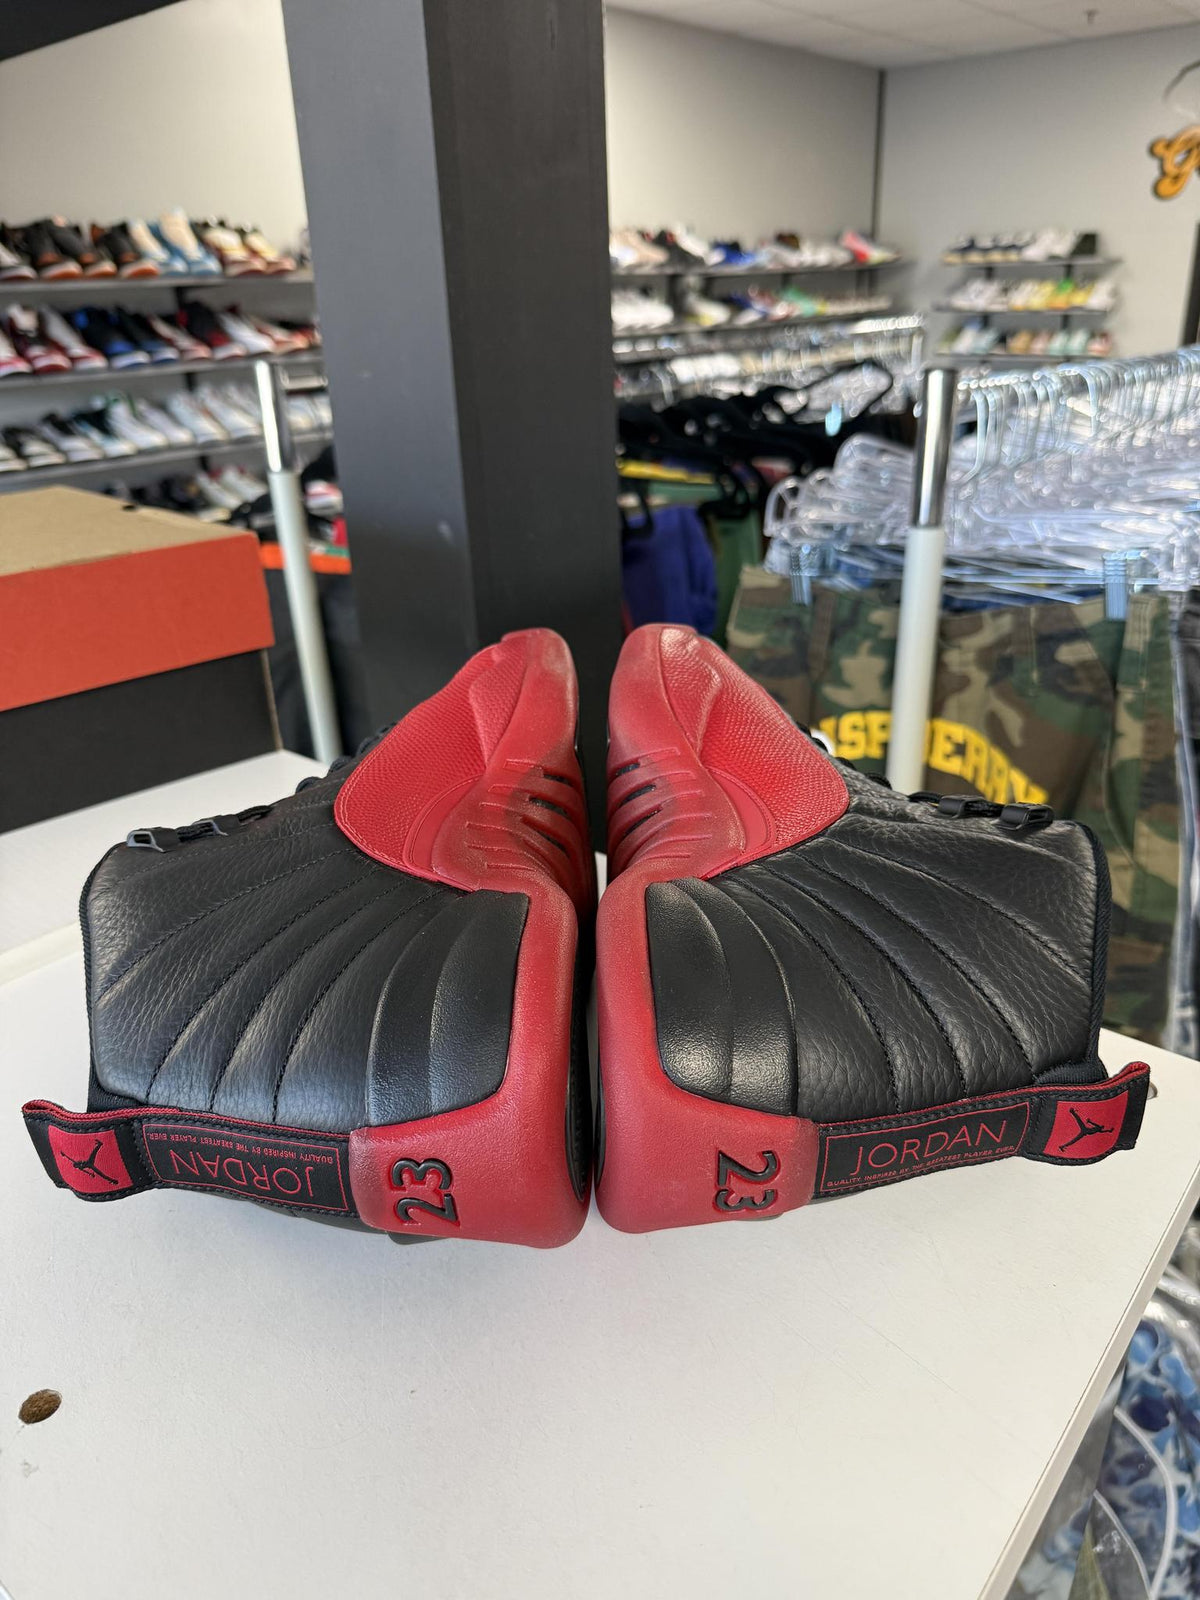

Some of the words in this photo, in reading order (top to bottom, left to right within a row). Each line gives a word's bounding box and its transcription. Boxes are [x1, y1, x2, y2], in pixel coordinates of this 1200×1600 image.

[170, 1134, 197, 1143] PLAYER
[200, 1136, 234, 1149] GREATEST
[236, 1142, 249, 1153] THE
[251, 1145, 261, 1154] BY
[263, 1147, 297, 1160] INSPIRED
[849, 1120, 1007, 1176] JORDAN
[299, 1152, 334, 1165] QUALITY
[169, 1149, 314, 1198] JORDAN
[827, 1177, 861, 1187] QUALITY
[864, 1170, 897, 1181] INSPIRED
[926, 1153, 961, 1166] GREATEST
[963, 1149, 993, 1158] PLAYER
[713, 1149, 780, 1213] 23
[391, 1157, 459, 1226] 23
